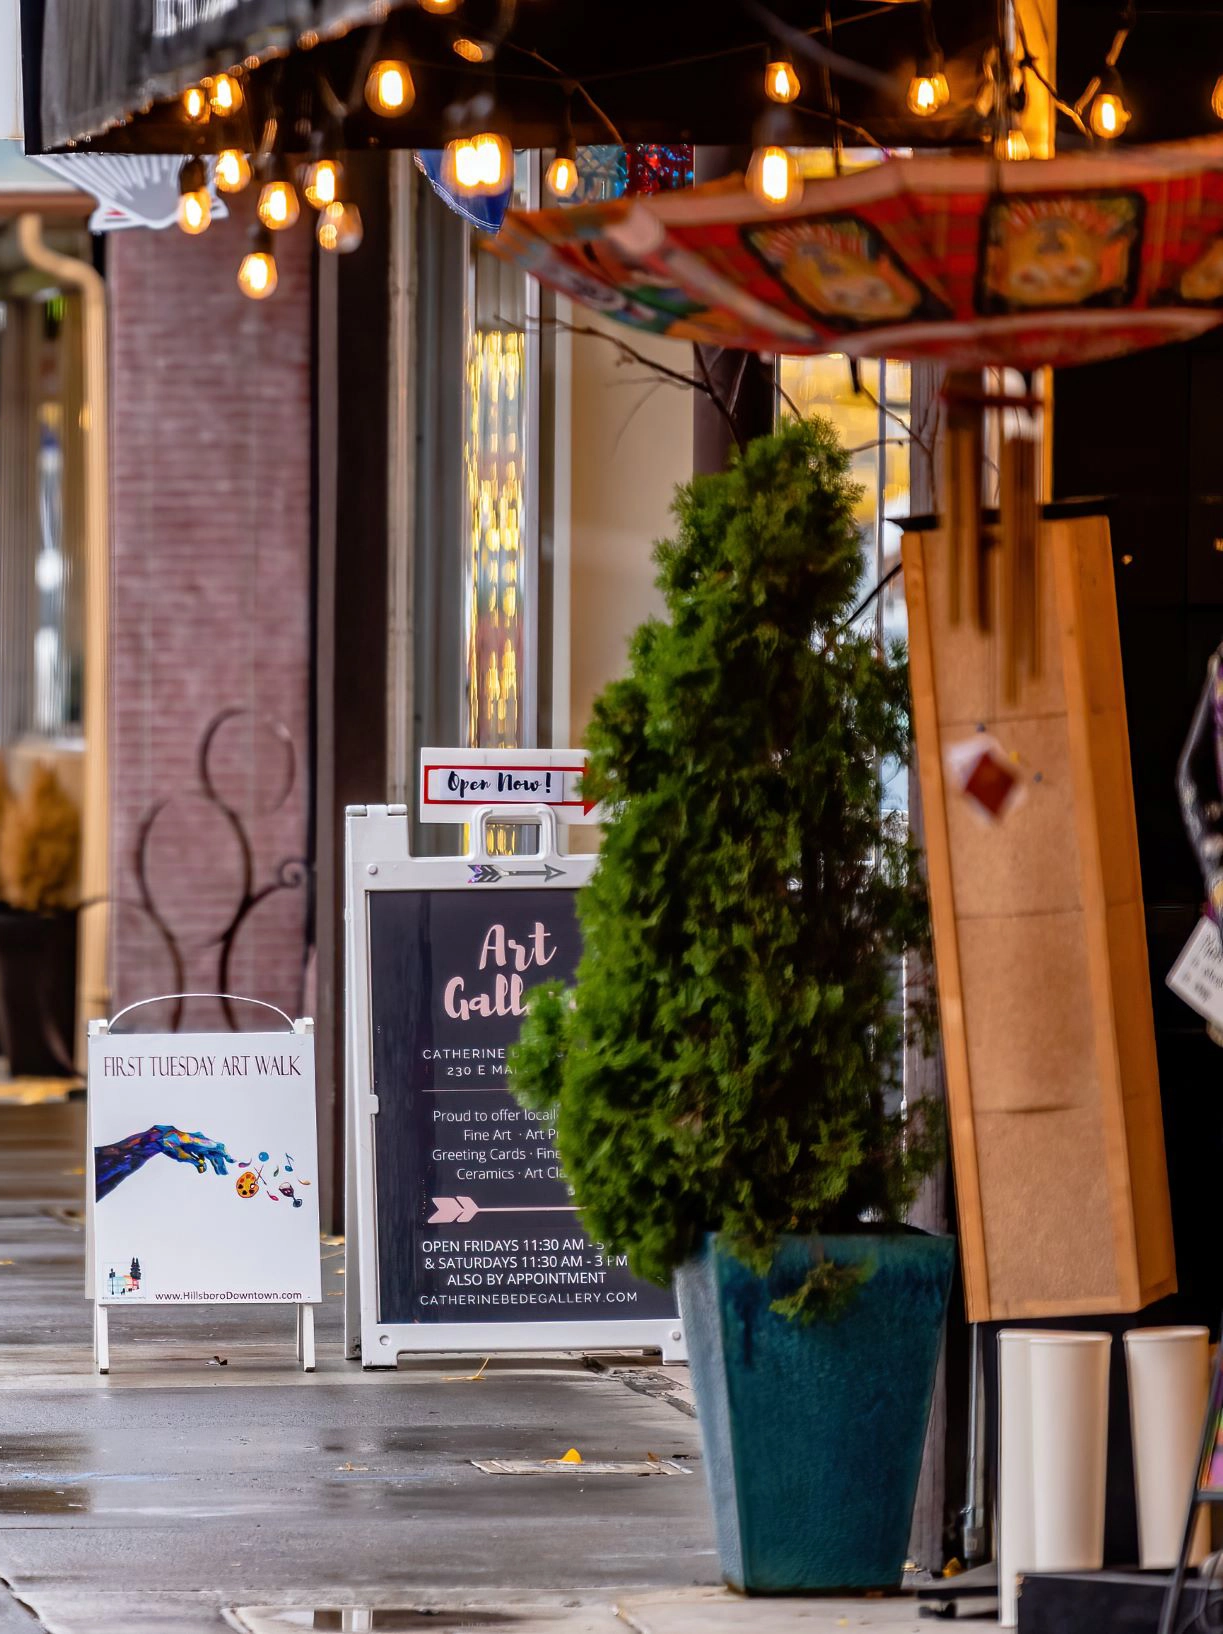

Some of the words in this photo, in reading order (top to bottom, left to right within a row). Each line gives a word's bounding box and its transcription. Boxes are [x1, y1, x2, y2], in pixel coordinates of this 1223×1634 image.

[448, 770, 491, 798] Open
[479, 922, 557, 971] Art
[422, 1049, 505, 1060] CATHERINE
[104, 1055, 144, 1077] FIRST
[149, 1055, 216, 1077] TUESDAY
[221, 1055, 250, 1076] ART
[255, 1055, 302, 1076] WALK
[447, 1066, 472, 1077] 230
[478, 1065, 486, 1075] E
[433, 1110, 471, 1122] Proud
[475, 1111, 488, 1122] to
[491, 1108, 520, 1122] offer
[524, 1108, 560, 1121] locall
[464, 1129, 490, 1141] Fine
[493, 1129, 512, 1141] Art
[526, 1128, 544, 1140] Art
[432, 1149, 487, 1163] Greeting
[490, 1148, 527, 1161] Cards
[536, 1147, 561, 1160] Fine
[457, 1168, 515, 1180] Ceramics
[525, 1167, 543, 1179] Art
[422, 1240, 460, 1253] OPEN
[464, 1240, 519, 1252] FRIDAYS
[523, 1239, 559, 1251] 11:30
[563, 1238, 584, 1250] AM
[425, 1258, 435, 1269] &
[438, 1256, 517, 1269] SATURDAYS
[522, 1255, 557, 1268] 11:30
[561, 1255, 583, 1267] AM
[594, 1255, 603, 1267] 3
[607, 1255, 628, 1267] PM
[447, 1273, 483, 1286] ALSO
[487, 1273, 504, 1285] BY
[507, 1272, 607, 1285] APPOINTMENT
[155, 1290, 302, 1301] www.HillsboroDowntown.com
[420, 1292, 638, 1306] CATHERINEBEDEGALLERY.COM
